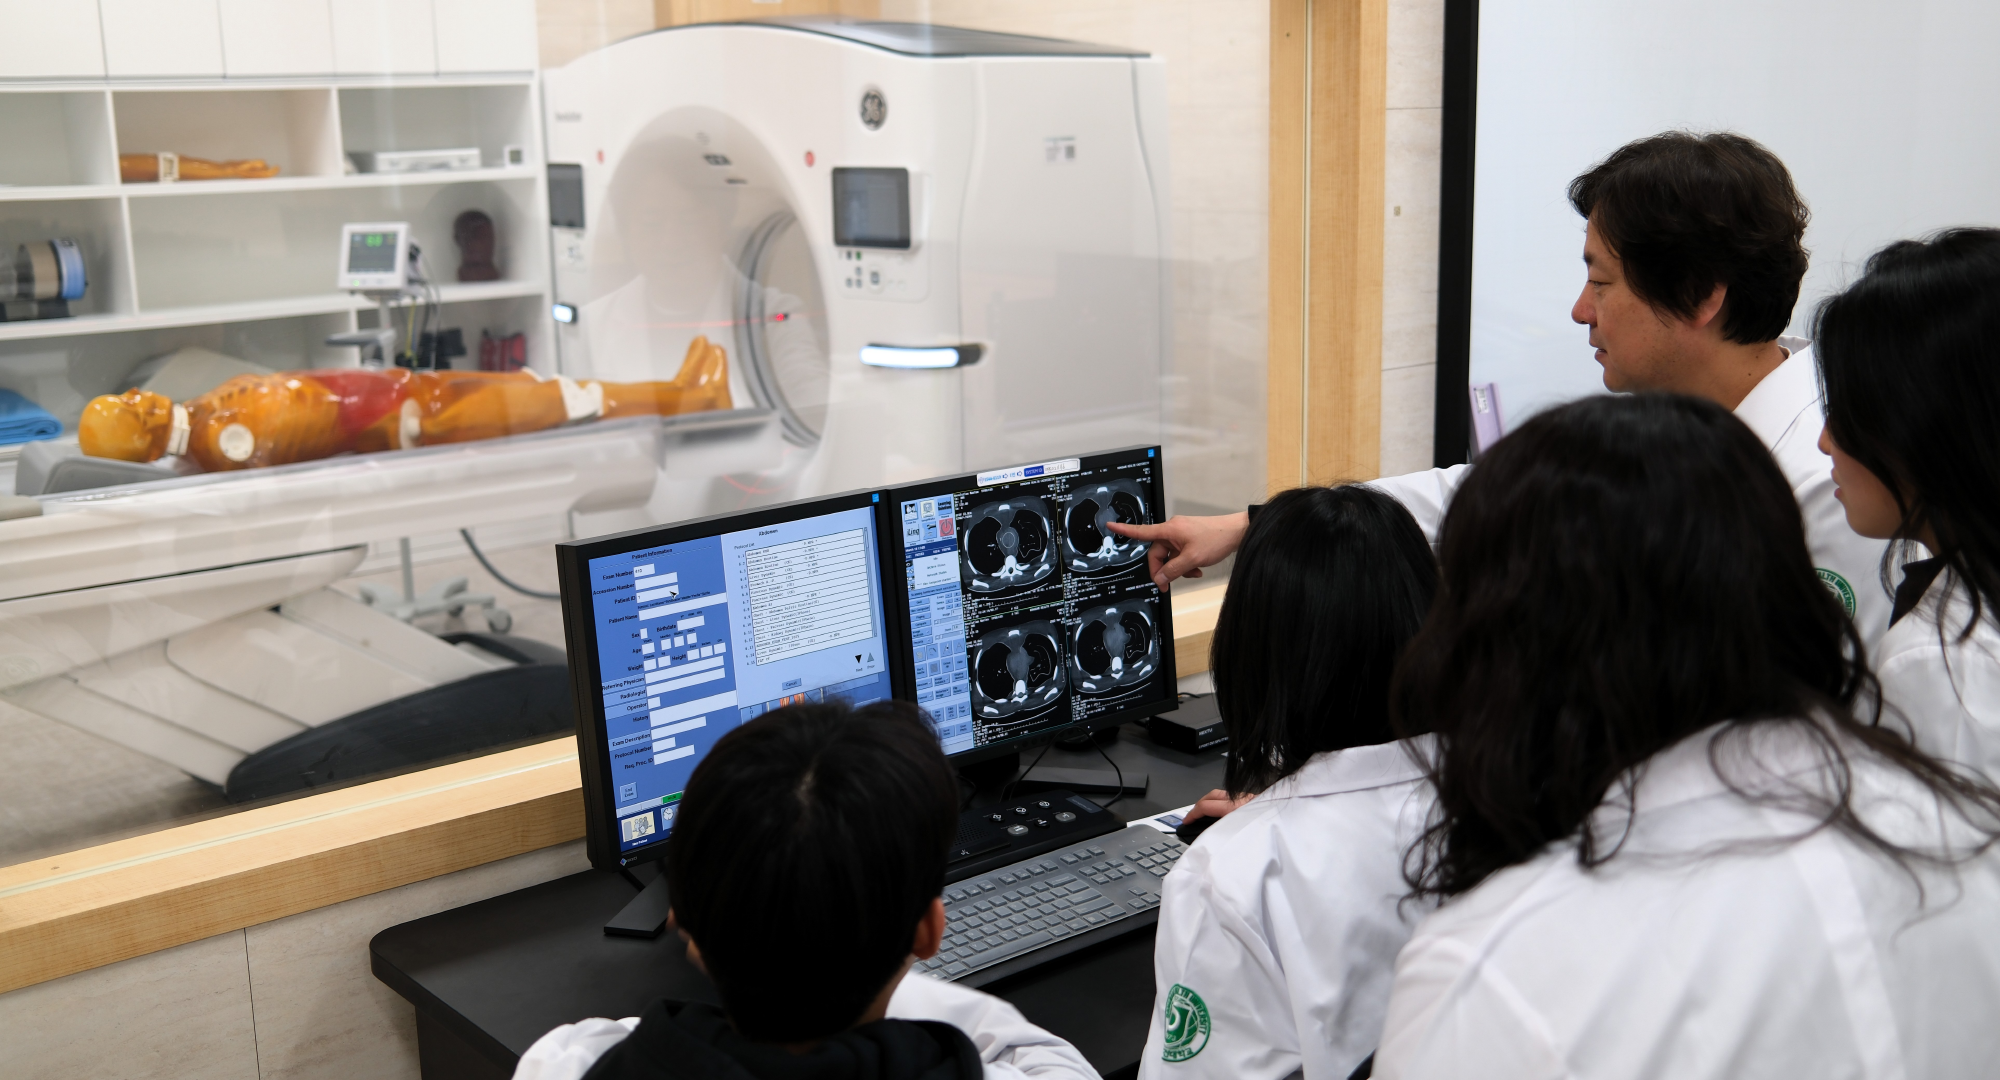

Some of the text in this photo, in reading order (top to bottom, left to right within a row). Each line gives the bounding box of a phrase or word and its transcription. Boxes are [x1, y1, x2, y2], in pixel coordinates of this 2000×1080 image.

[632, 548, 673, 560] Patient Information
[602, 572, 615, 580] Exam
[614, 570, 634, 578] Number
[592, 583, 634, 596] Accession Number
[608, 616, 624, 624] Patient
[656, 624, 676, 632] Birthdate
[672, 653, 686, 661] Height
[624, 676, 644, 686] Physician
[620, 689, 646, 700] Radiologist
[626, 702, 648, 712] Operator
[624, 733, 650, 743] Description
[614, 746, 652, 760] Protocol Number
